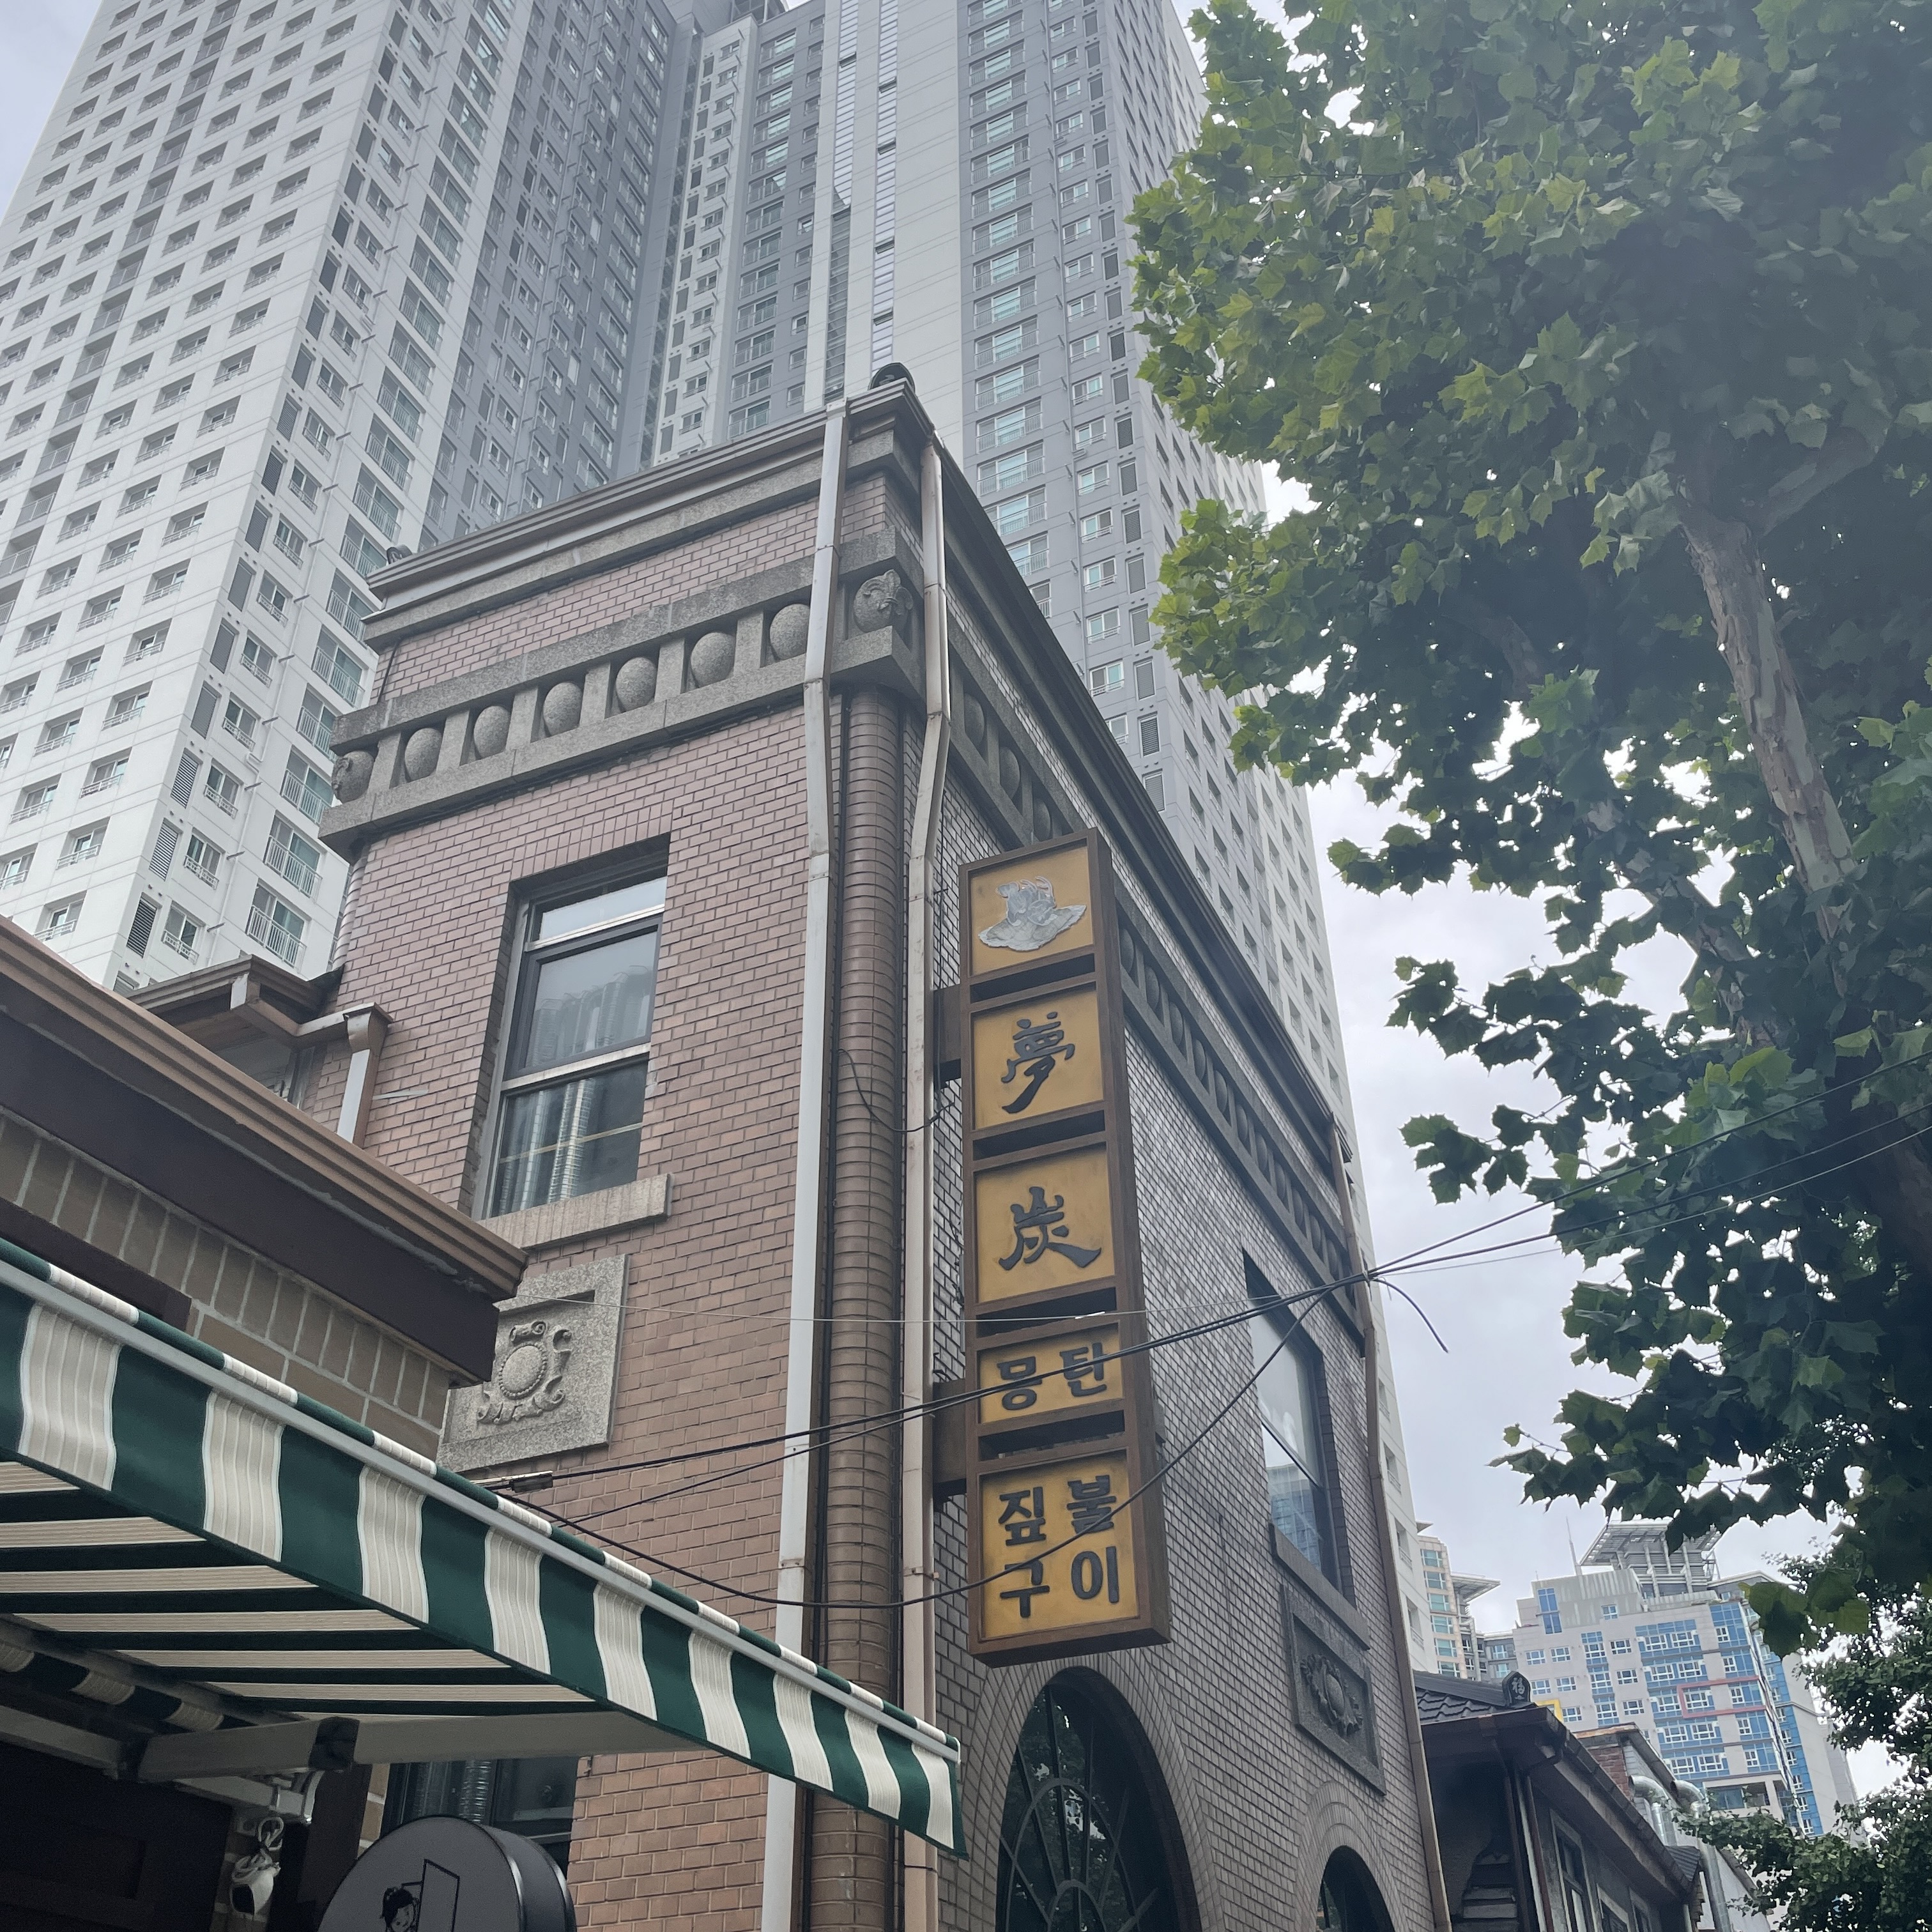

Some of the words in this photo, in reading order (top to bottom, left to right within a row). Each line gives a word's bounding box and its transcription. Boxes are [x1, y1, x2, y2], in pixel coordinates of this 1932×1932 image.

[997, 1343, 1107, 1411] 몽탄
[999, 1474, 1117, 1546] 짚불
[1000, 1546, 1119, 1618] 구이
